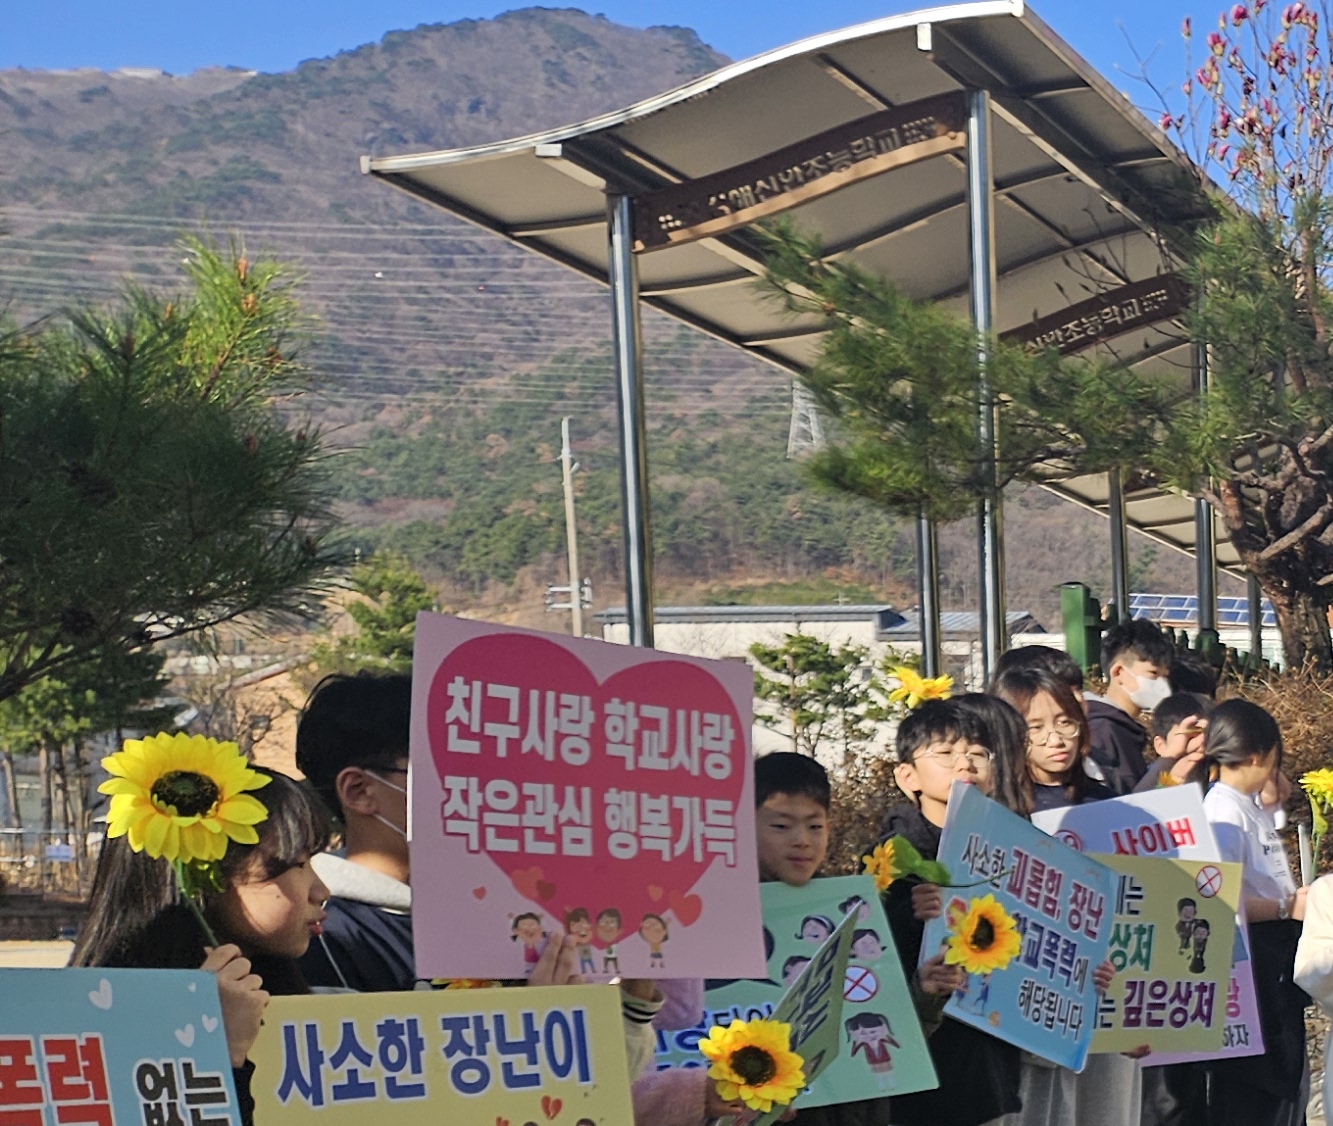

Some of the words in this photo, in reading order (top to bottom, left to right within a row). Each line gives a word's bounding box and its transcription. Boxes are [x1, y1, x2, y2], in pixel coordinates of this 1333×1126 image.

[444, 676, 596, 766] 친구사랑
[603, 697, 736, 780] 학교사랑
[443, 775, 593, 857] 작은관심
[603, 787, 738, 867] 행복가득
[1112, 817, 1196, 855] 사이버
[962, 834, 1006, 889] 사소한
[1006, 848, 1062, 922] 괴롭힘,
[1067, 881, 1104, 941] 장난
[1018, 979, 1083, 1040] 해당됩니다
[1122, 980, 1216, 1028] 깊은상처
[277, 1017, 427, 1107] 사소한
[441, 1009, 592, 1095] 장난이
